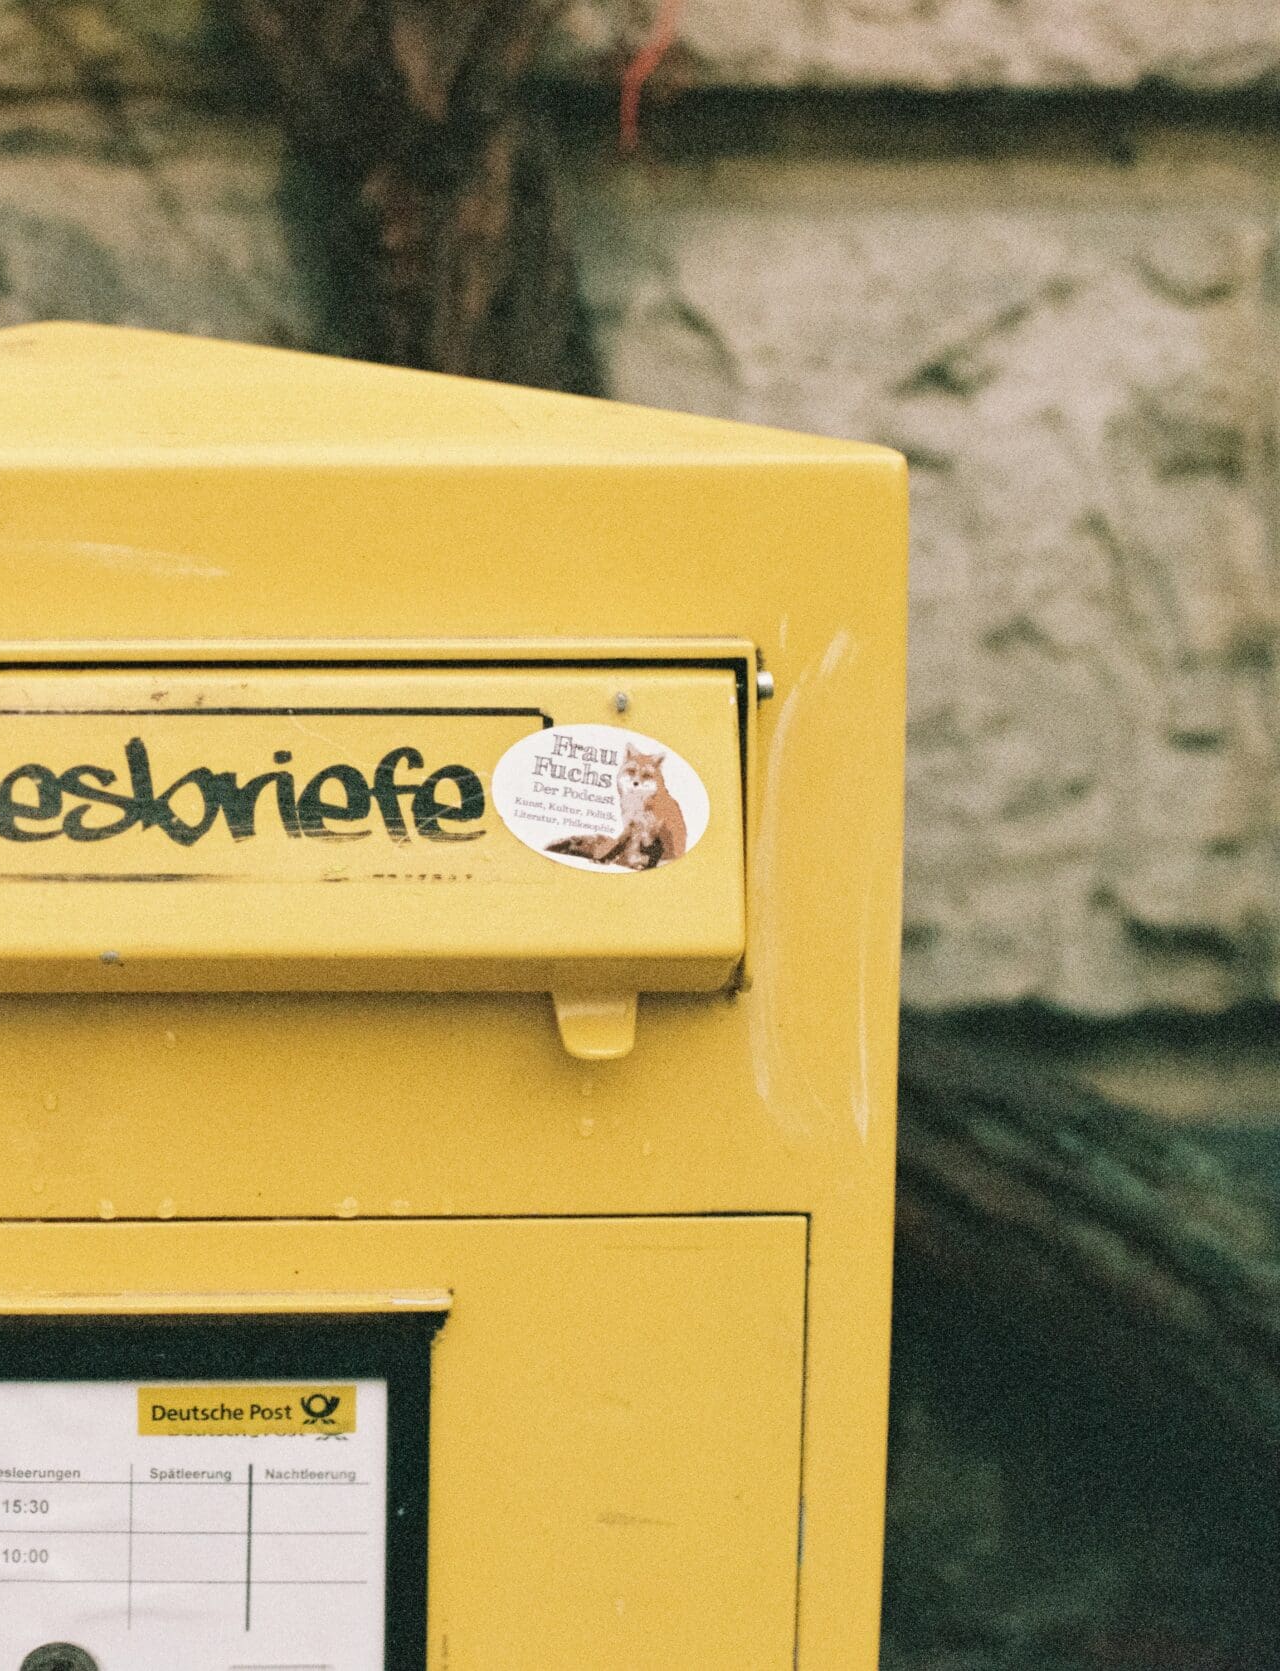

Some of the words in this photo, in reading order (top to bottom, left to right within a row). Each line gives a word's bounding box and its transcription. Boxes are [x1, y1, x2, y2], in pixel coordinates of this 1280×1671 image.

[551, 734, 618, 766] Frau
[531, 755, 612, 788] Fuchs
[533, 781, 559, 796] Der
[562, 786, 615, 806] Podcast
[151, 1403, 244, 1421] Deutsche
[250, 1404, 292, 1420] Post
[150, 1468, 232, 1482] Spätleerung
[265, 1468, 356, 1482] Nachtleerung
[2, 1500, 50, 1514] 15:30
[2, 1549, 50, 1563] 10:00
